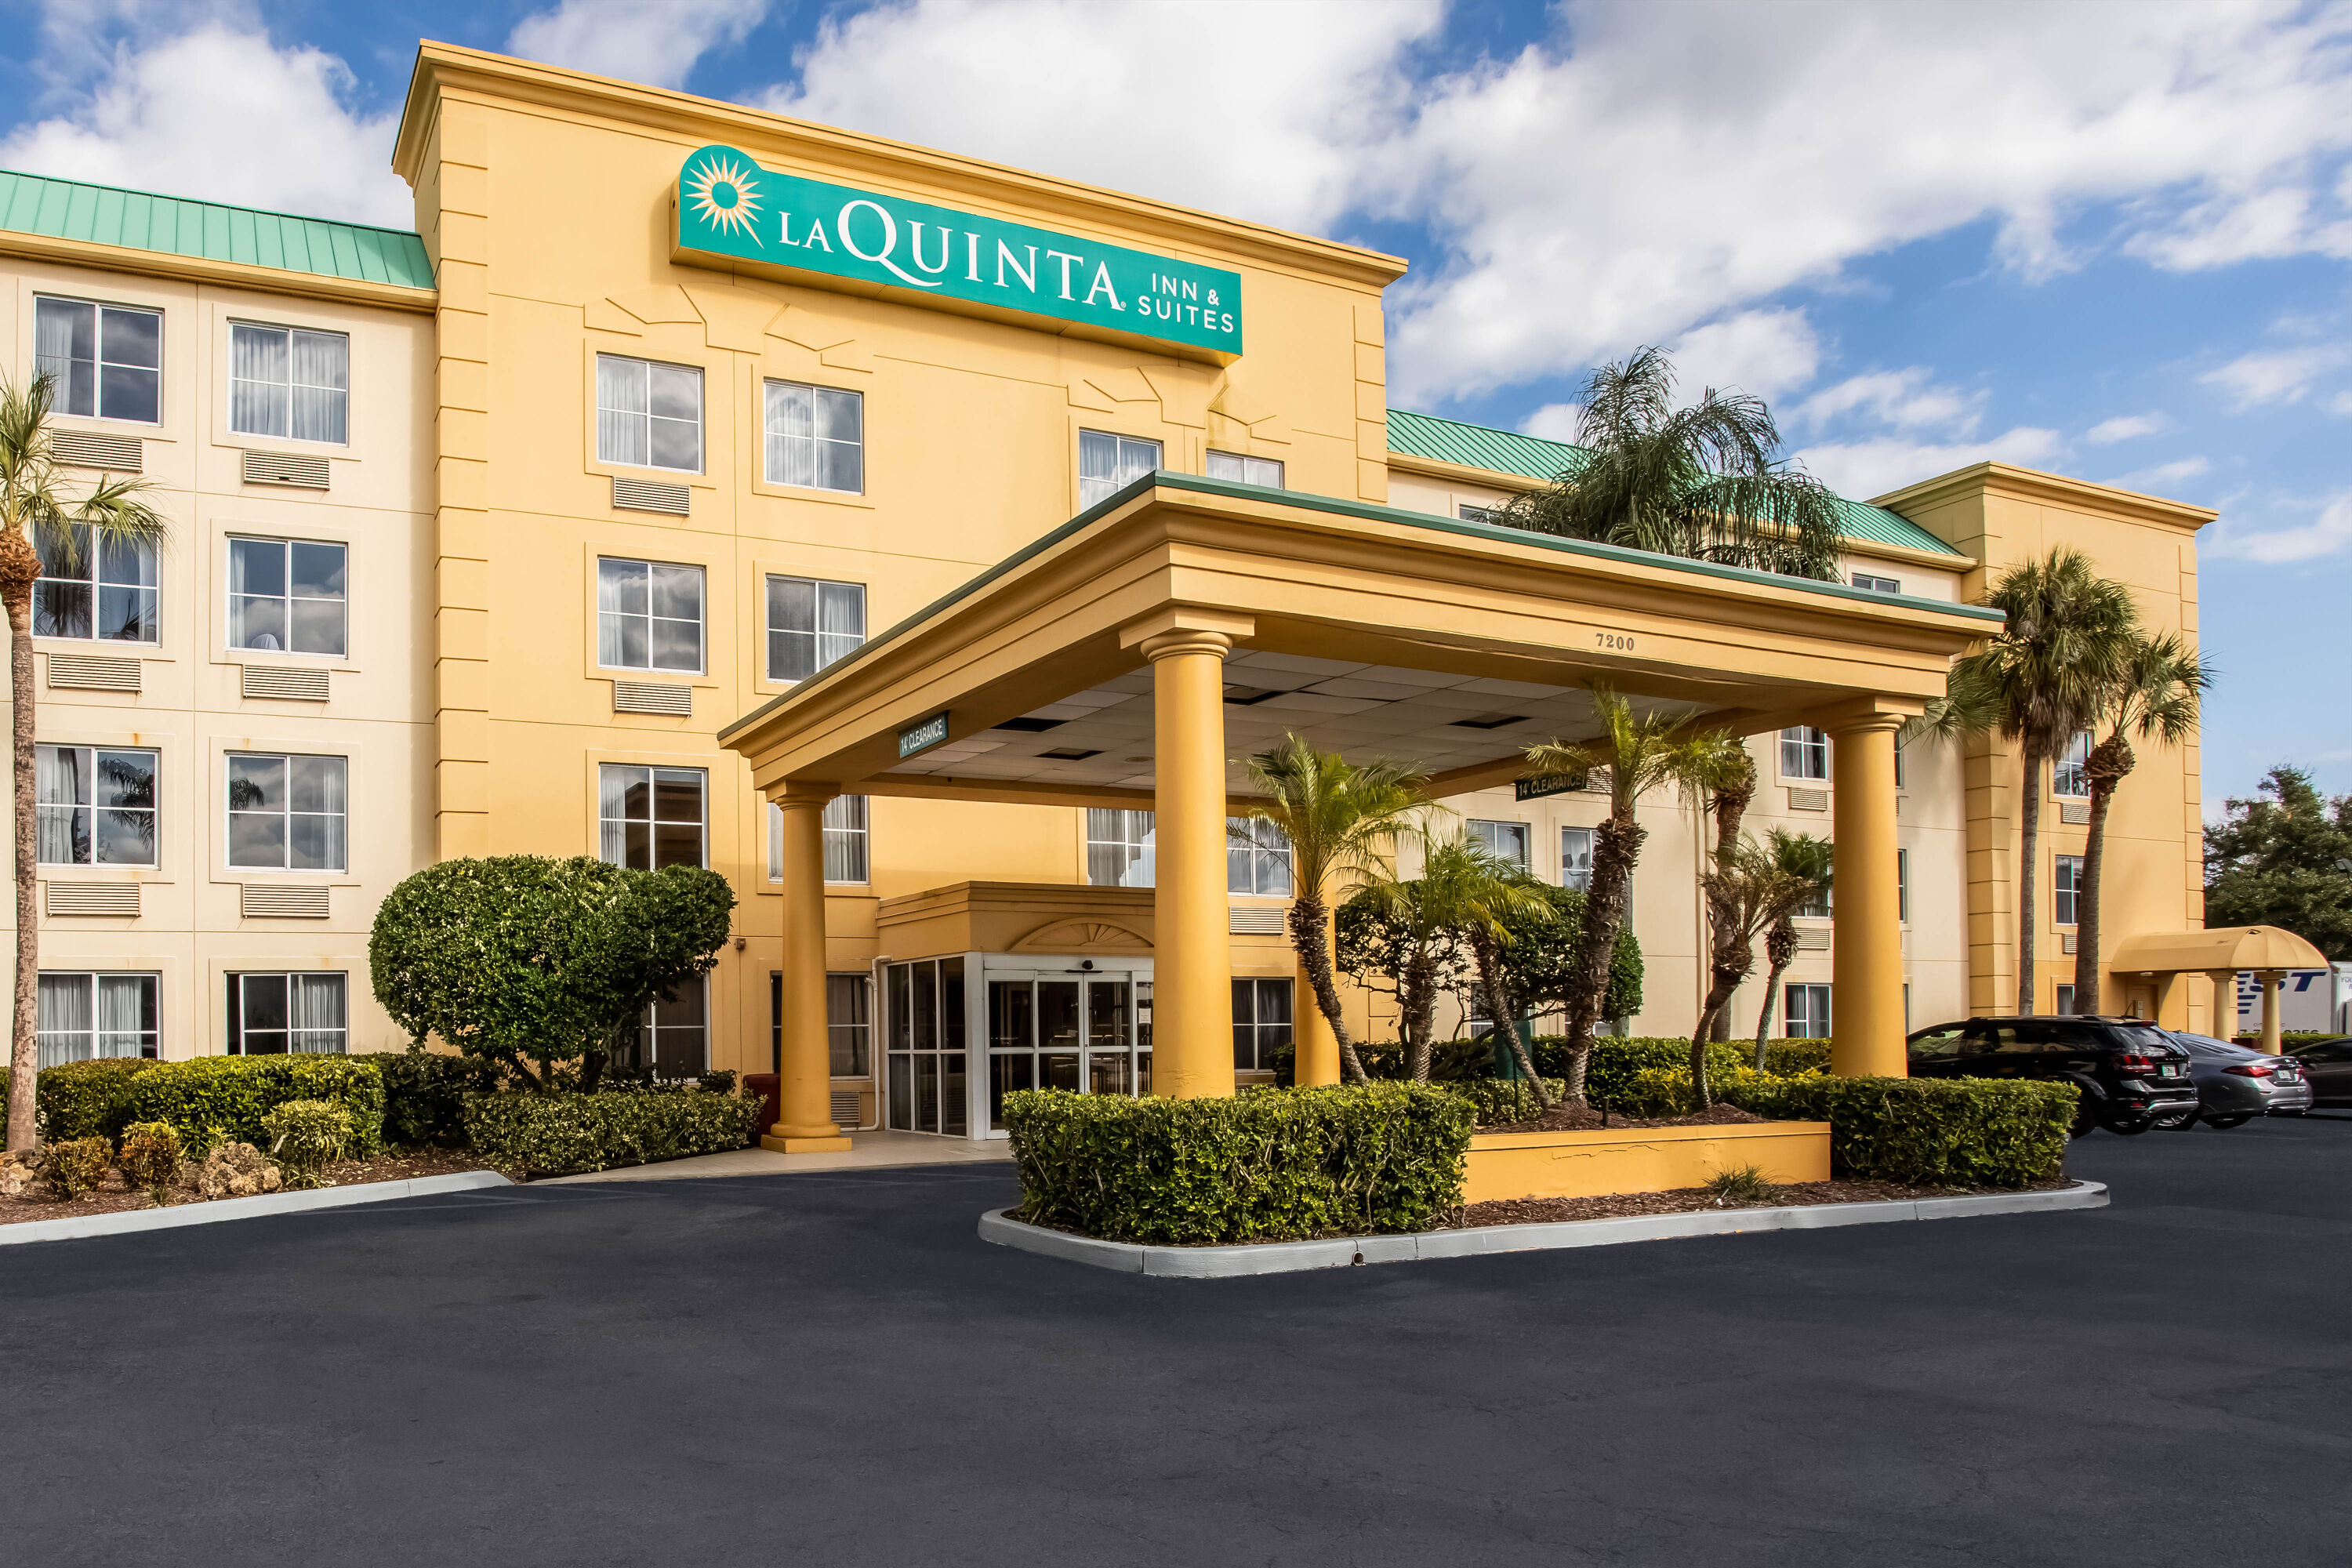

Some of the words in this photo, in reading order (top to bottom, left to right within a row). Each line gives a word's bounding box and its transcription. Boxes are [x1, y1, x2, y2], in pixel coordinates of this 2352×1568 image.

[779, 211, 834, 253] LA
[837, 199, 1126, 311] QUINTA
[1152, 273, 1197, 301] INN
[1207, 289, 1220, 307] &
[1138, 295, 1234, 333] SUITES
[1595, 633, 1635, 651] 7200
[909, 719, 943, 750] CLEARANCE
[1531, 775, 1582, 794] CLEARANCE
